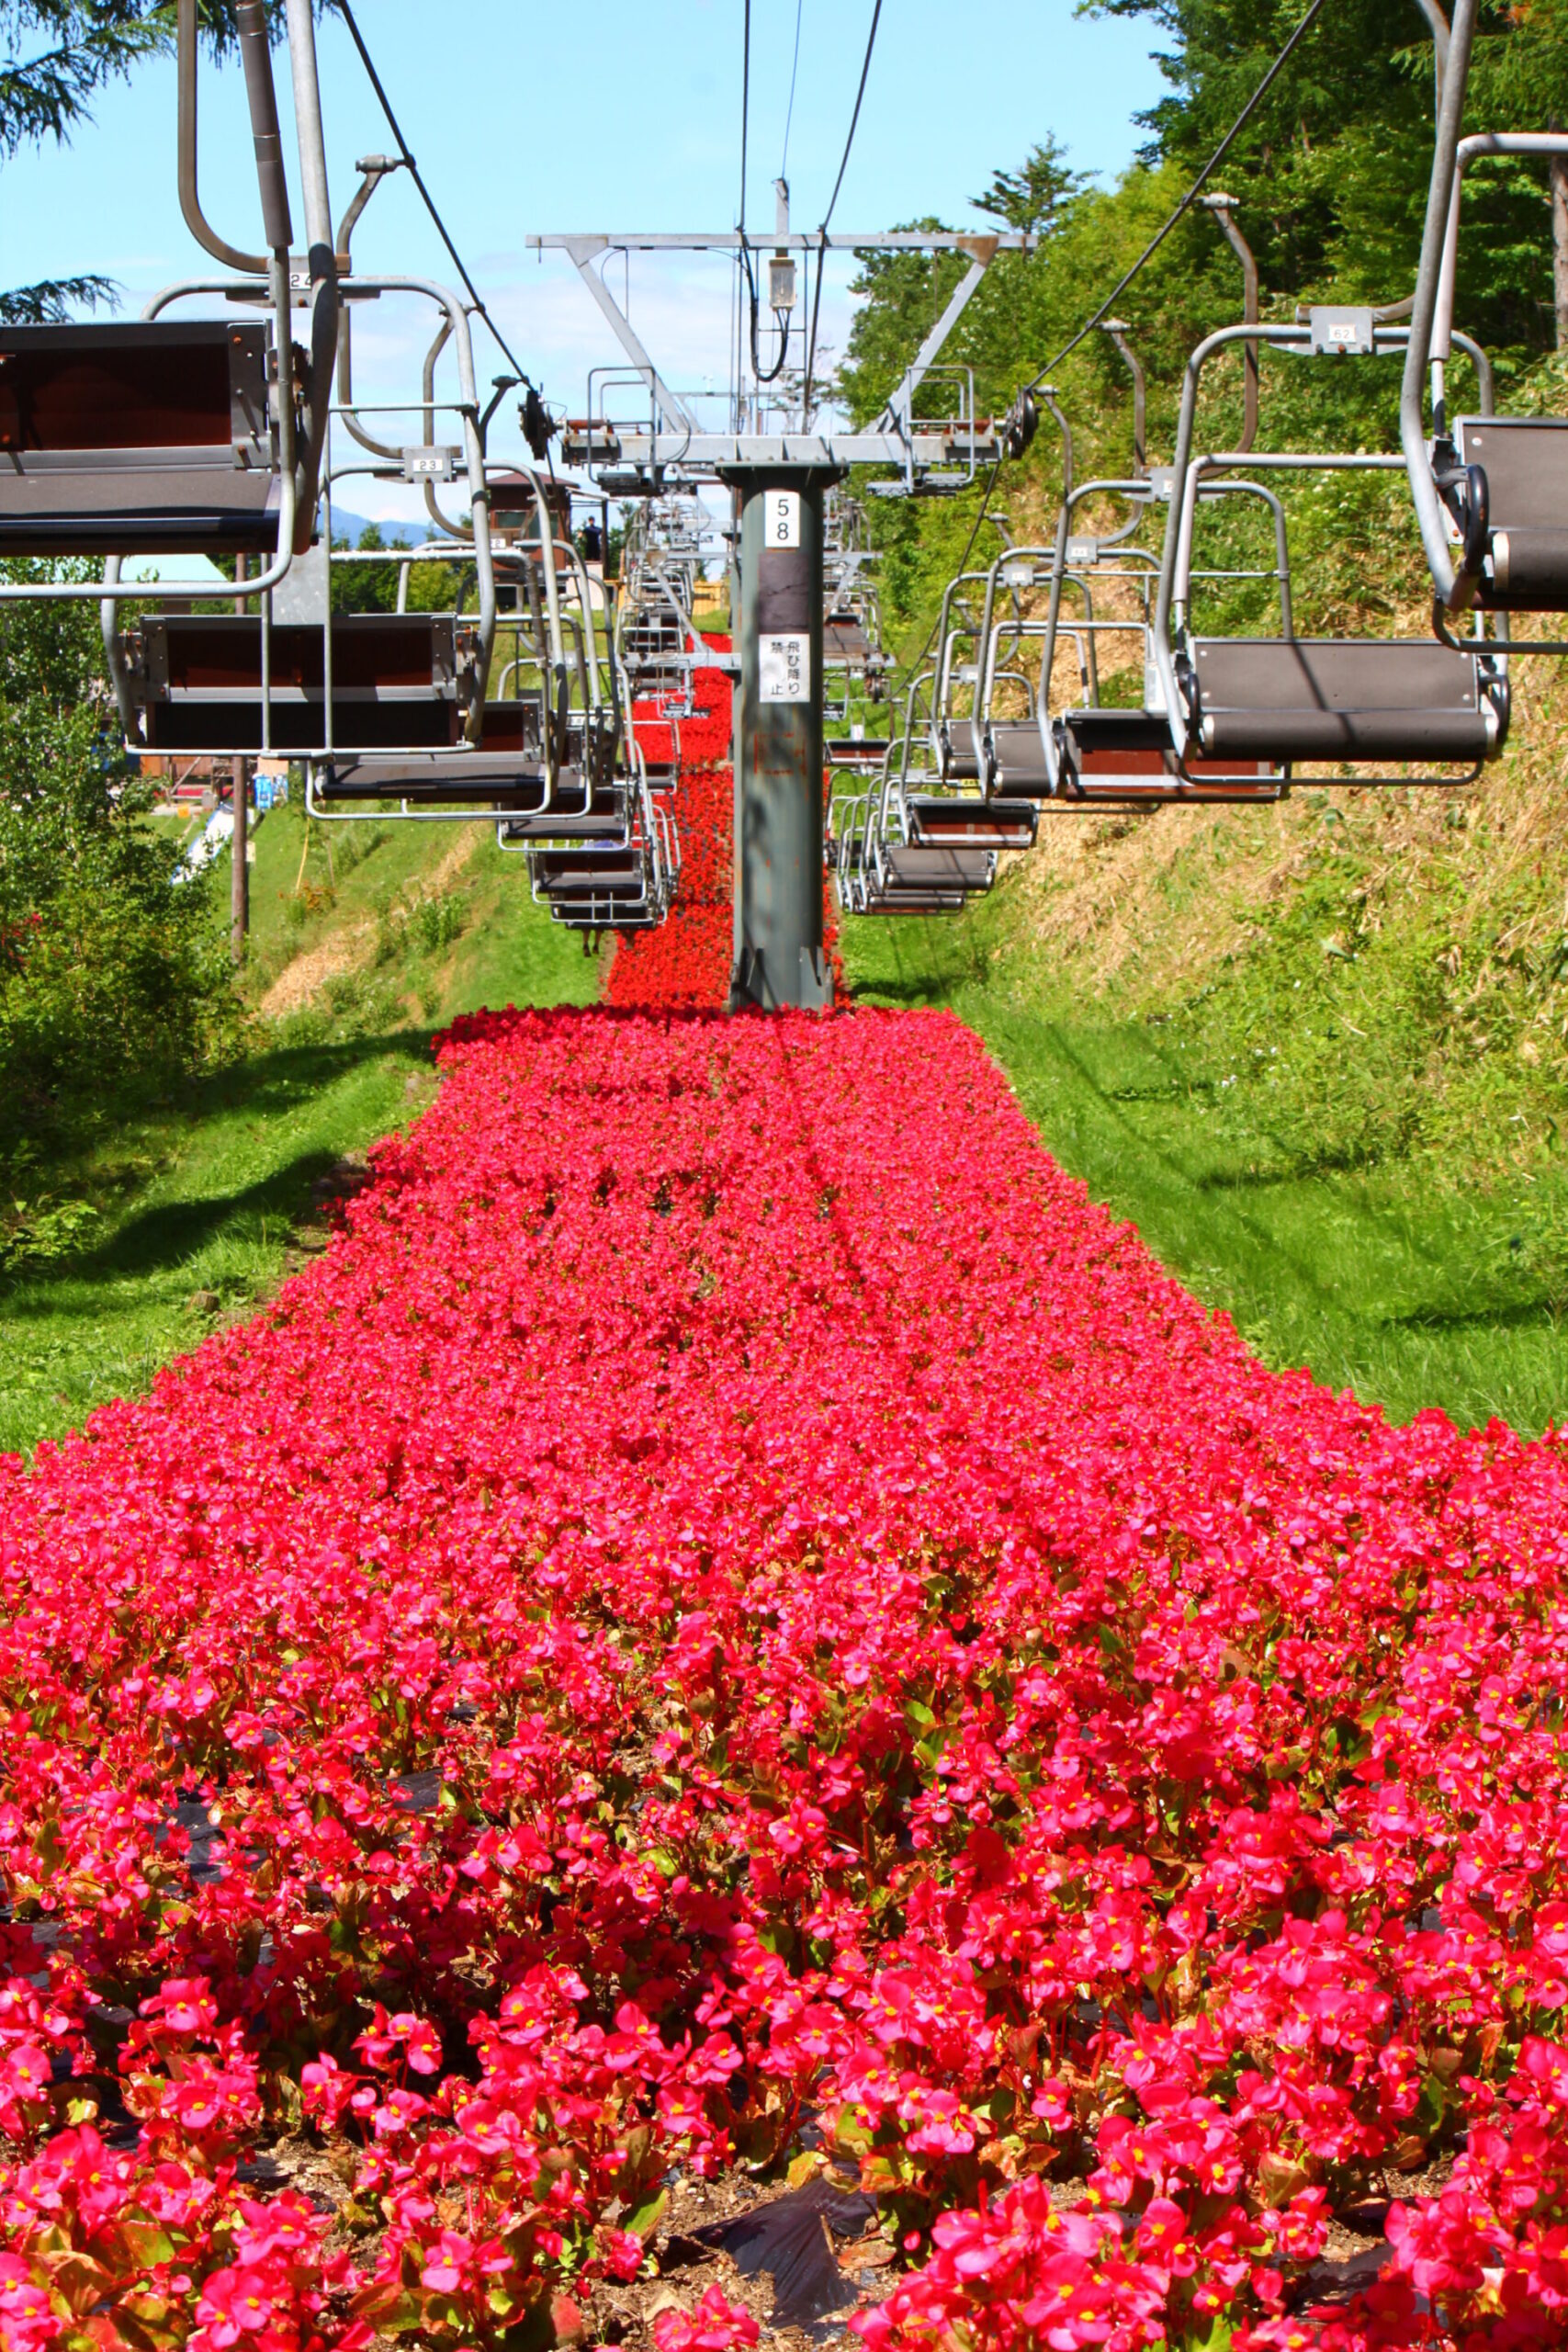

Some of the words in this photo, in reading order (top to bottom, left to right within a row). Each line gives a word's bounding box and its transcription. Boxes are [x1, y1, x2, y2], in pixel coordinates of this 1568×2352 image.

[1334, 329, 1350, 339] 62
[420, 460, 436, 470] 23
[771, 641, 784, 695] 禁止
[787, 640, 801, 695] 飛び降り
